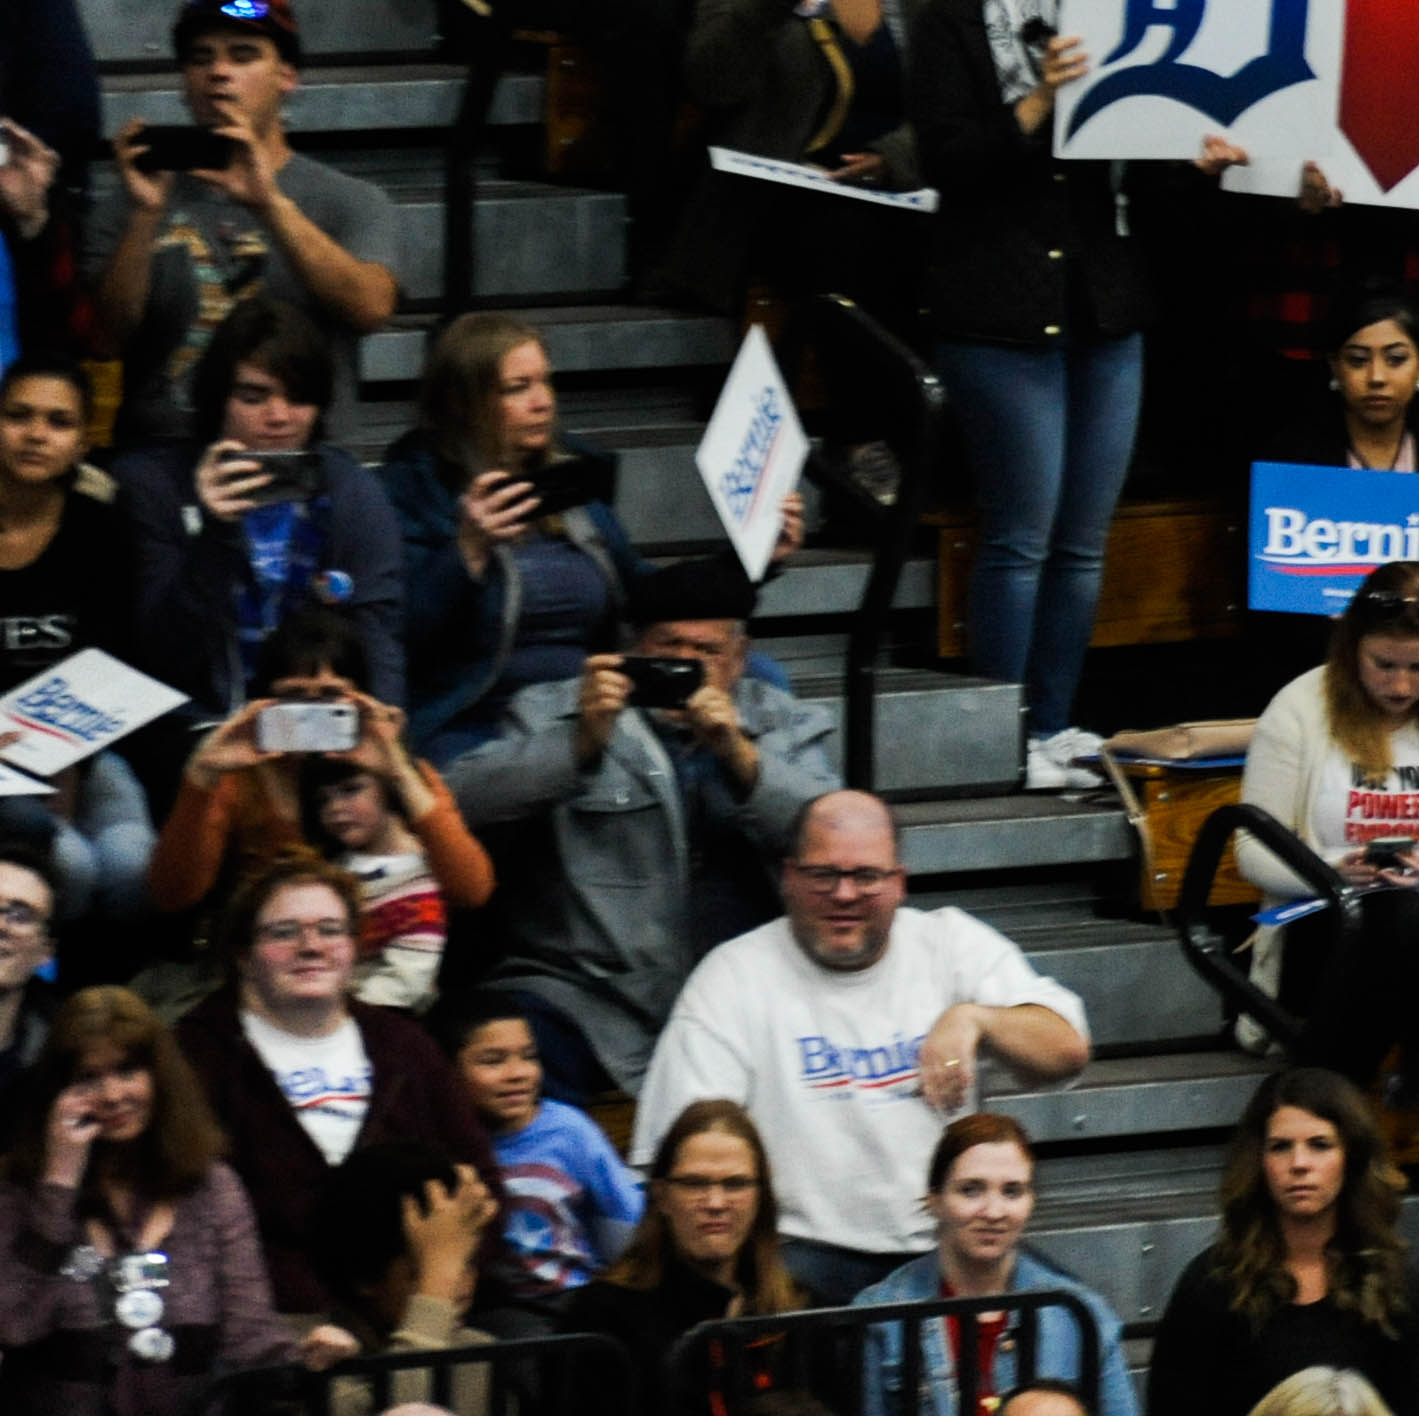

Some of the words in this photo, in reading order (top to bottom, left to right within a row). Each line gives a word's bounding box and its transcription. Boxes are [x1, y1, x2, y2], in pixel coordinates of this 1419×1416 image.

[720, 384, 778, 519] Bernie
[17, 678, 124, 743] Bernie
[800, 1032, 928, 1078] Bernie
